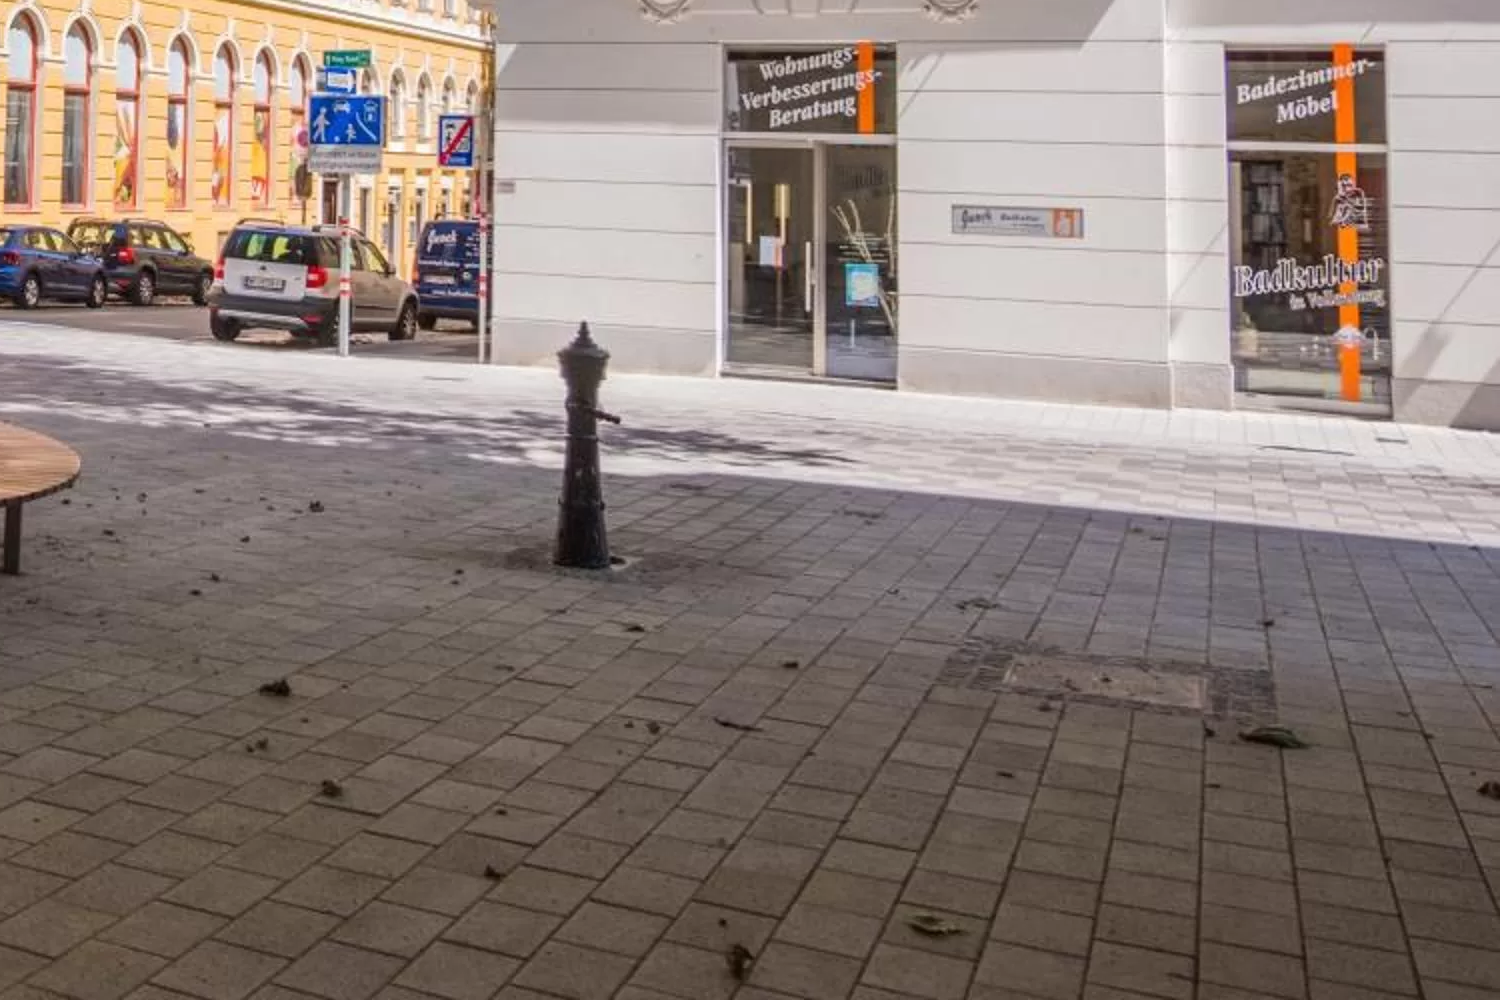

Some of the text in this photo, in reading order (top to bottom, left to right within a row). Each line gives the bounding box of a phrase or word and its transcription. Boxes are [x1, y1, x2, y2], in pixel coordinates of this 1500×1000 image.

[759, 47, 859, 81] Wohnungs-
[1236, 58, 1376, 104] Badezimmer-
[740, 69, 883, 110] Verbesserungs-
[1276, 89, 1338, 123] Möbel
[769, 96, 857, 129] Beratung
[1233, 253, 1385, 297] Badkultur
